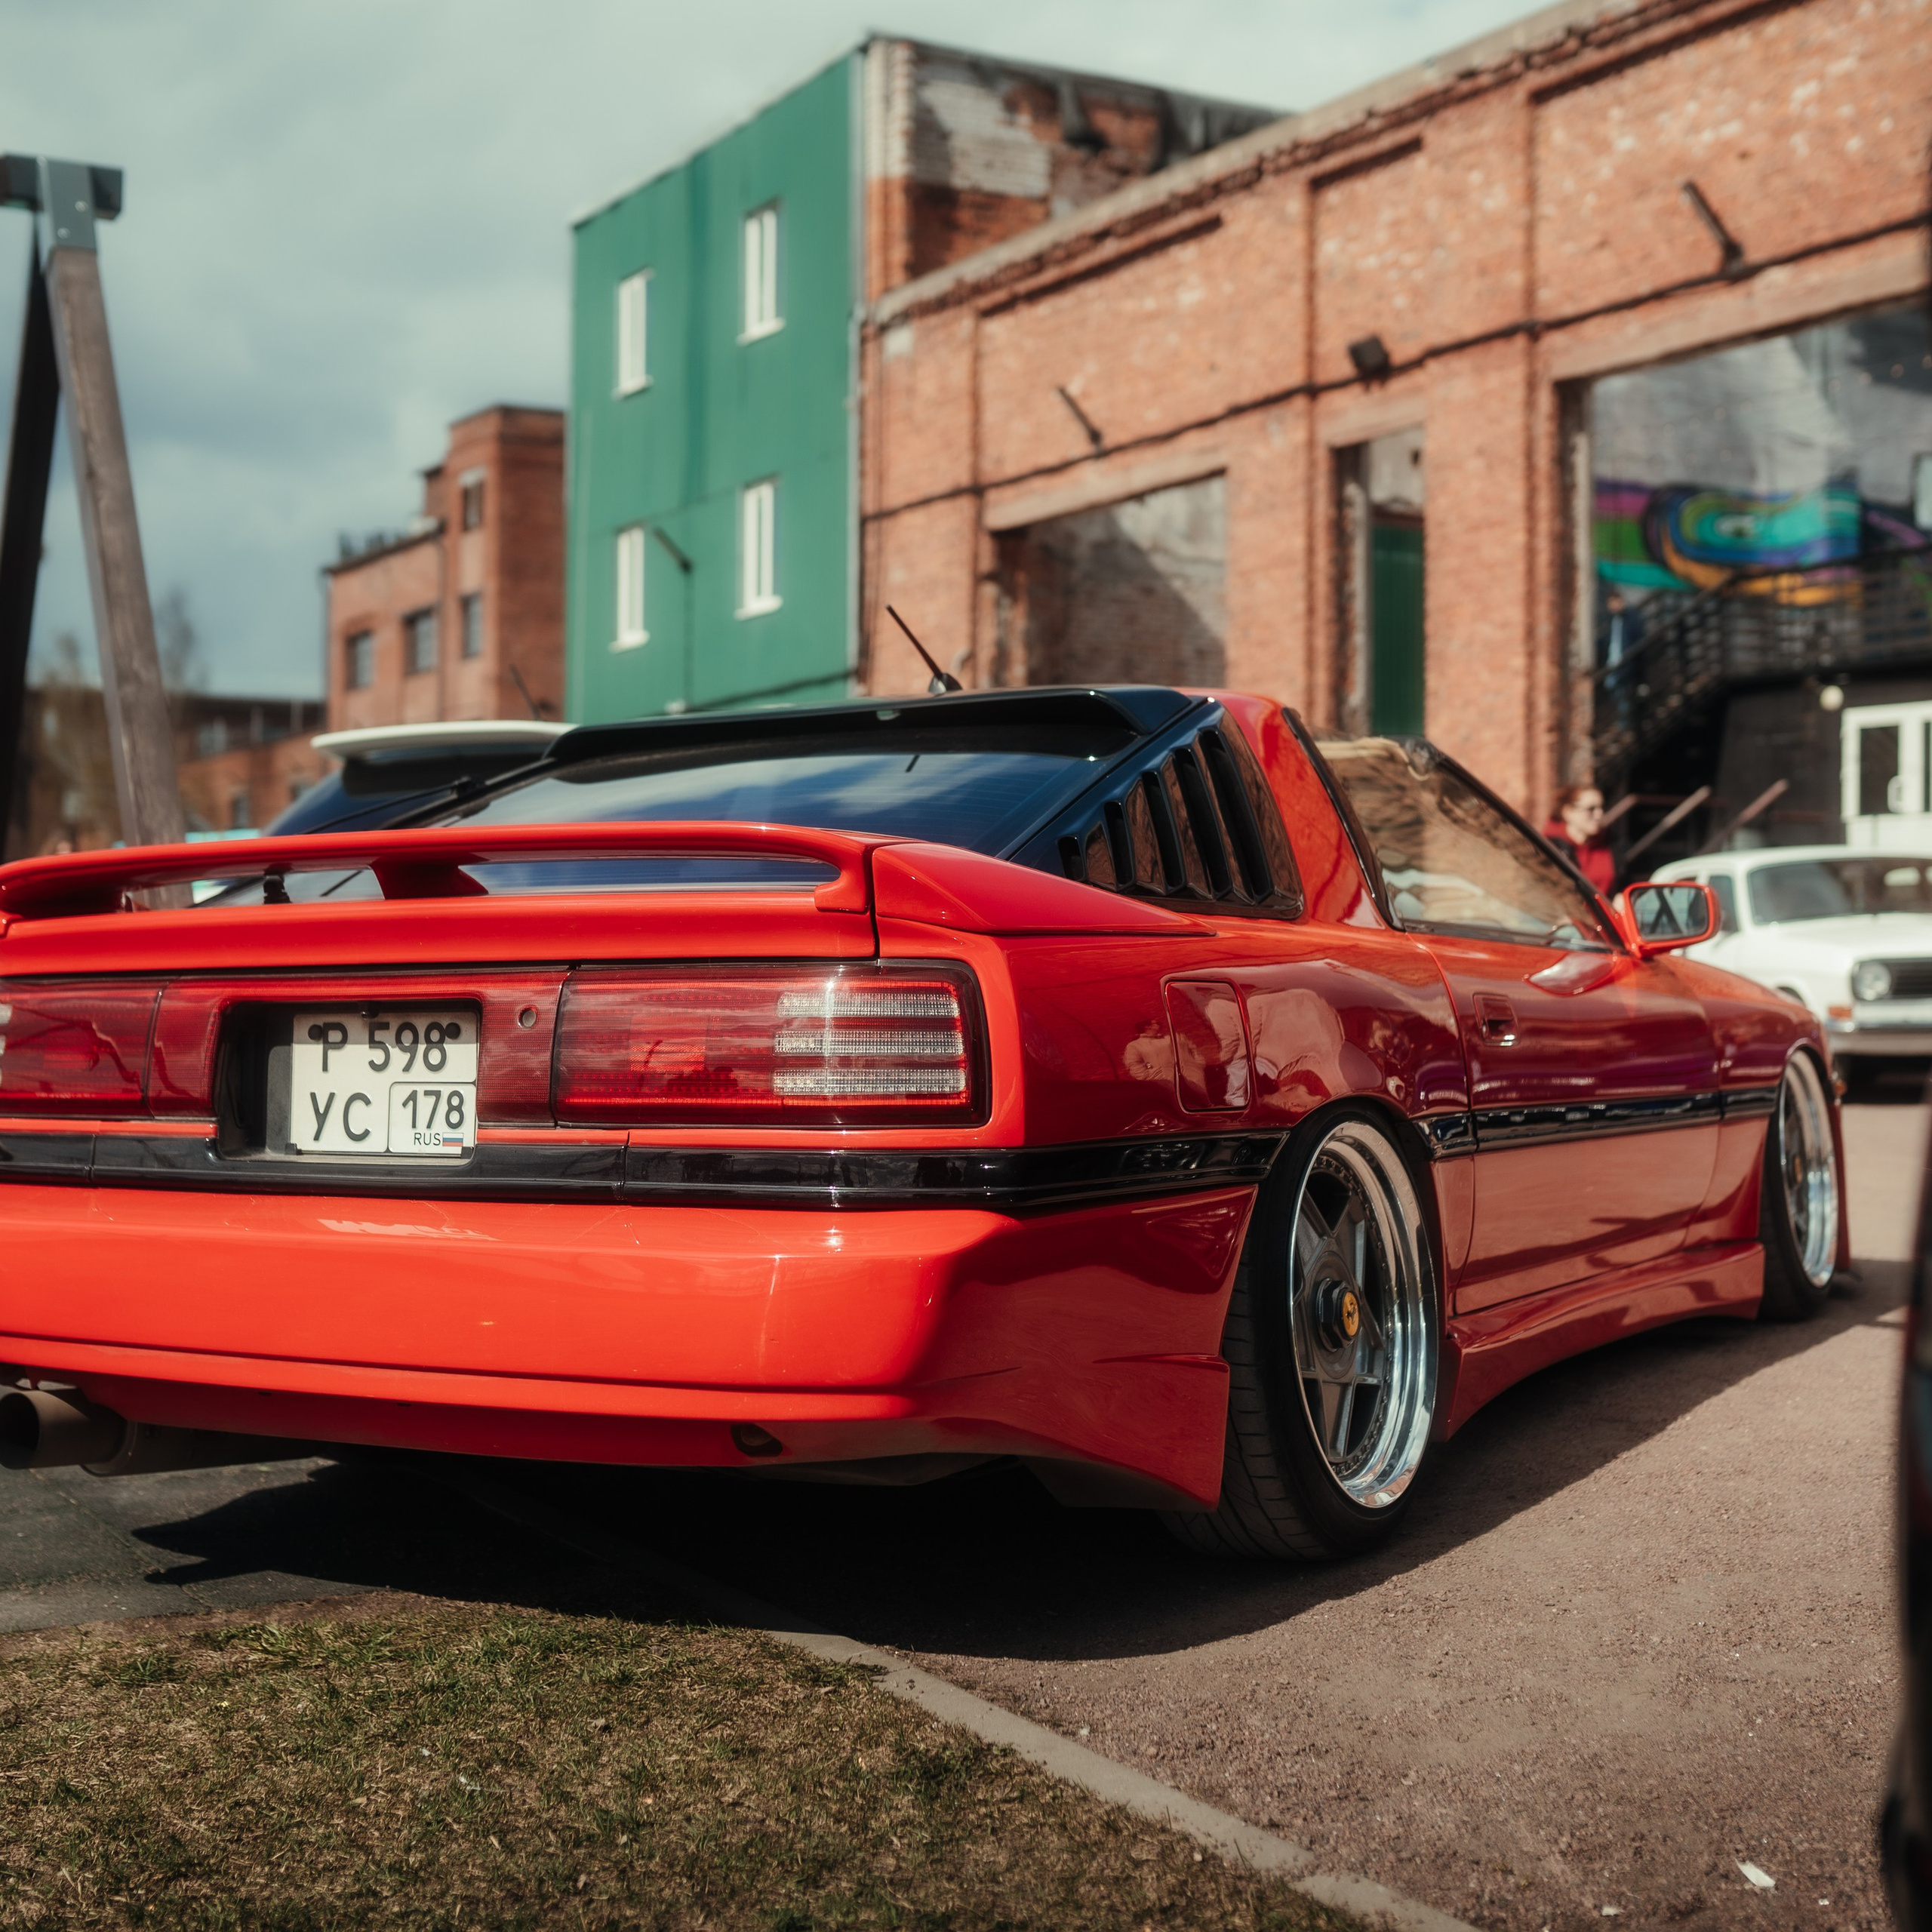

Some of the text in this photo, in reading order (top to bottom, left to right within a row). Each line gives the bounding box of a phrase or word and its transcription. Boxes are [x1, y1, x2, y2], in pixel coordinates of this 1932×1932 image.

[368, 1022, 447, 1072] 598
[401, 1090, 464, 1129] 178
[414, 1132, 441, 1146] RUS
